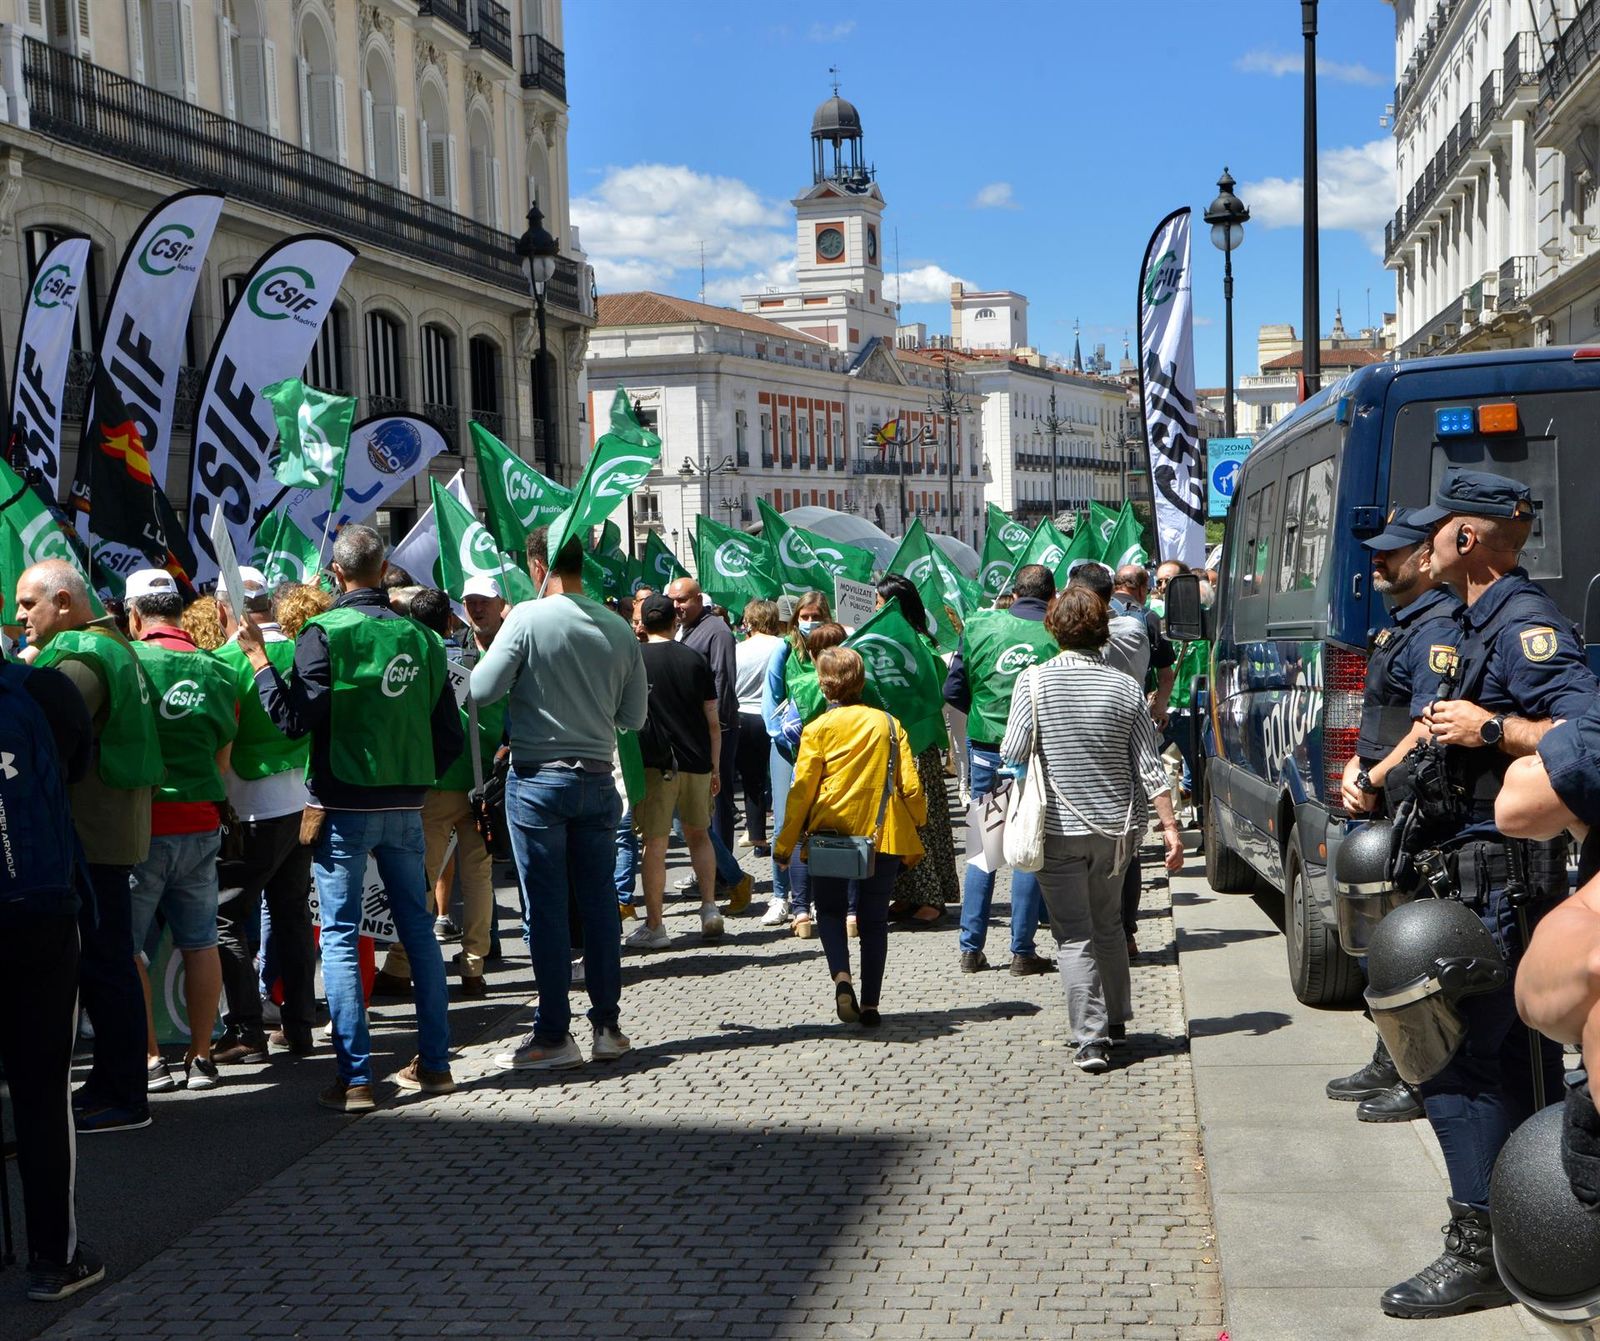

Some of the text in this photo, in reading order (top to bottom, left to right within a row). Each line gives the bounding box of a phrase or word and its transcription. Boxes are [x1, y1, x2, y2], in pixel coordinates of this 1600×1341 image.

[151, 238, 194, 262] CSIF
[264, 279, 319, 314] CSIF
[292, 313, 318, 329] Madrid
[1147, 349, 1205, 527] CSIF
[1224, 444, 1252, 452] ZONA
[96, 550, 143, 574] CSIF
[858, 642, 911, 688] CSIF
